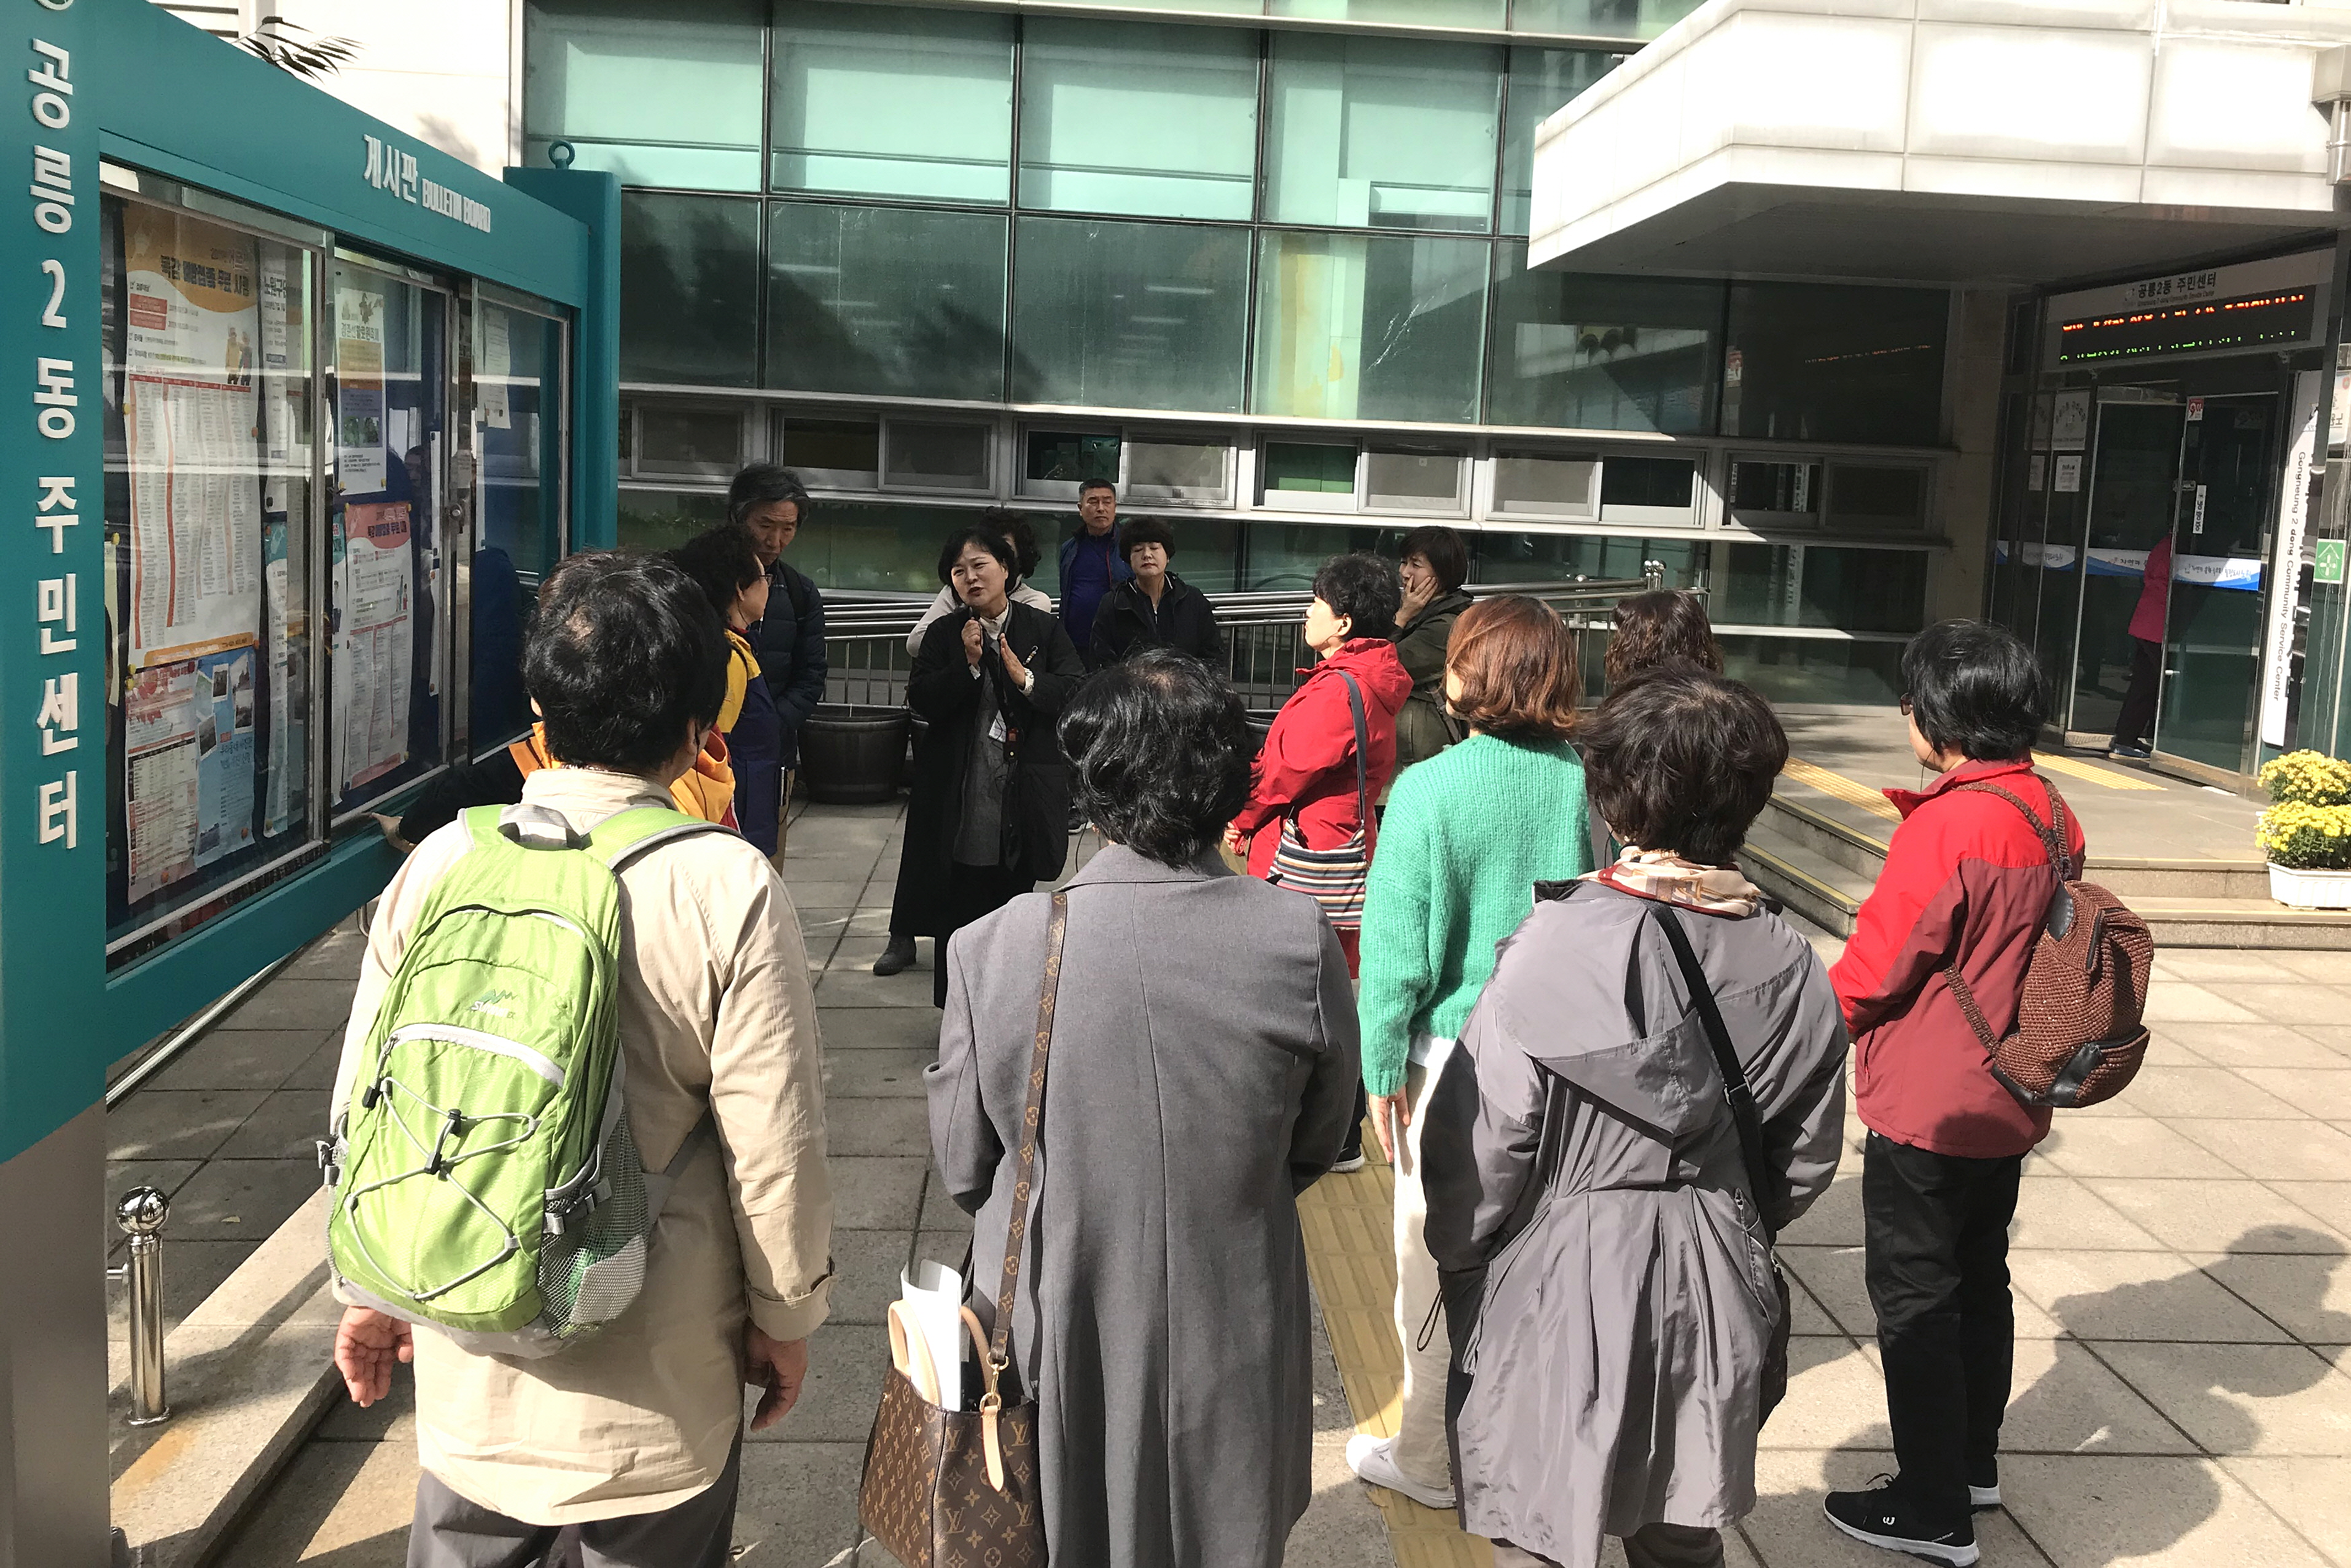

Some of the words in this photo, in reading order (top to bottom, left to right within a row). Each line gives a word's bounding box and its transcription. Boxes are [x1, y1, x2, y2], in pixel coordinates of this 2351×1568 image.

[363, 134, 418, 204] 게시판
[422, 178, 462, 222] BULLETIN
[463, 196, 491, 233] BOARD
[2138, 279, 2172, 298] 공릉2동
[2177, 272, 2216, 292] 주민센터
[2291, 451, 2306, 513] Gongneung
[2283, 529, 2296, 559] dong
[2279, 561, 2294, 619] Community
[36, 477, 78, 849] 주민센터
[2276, 622, 2288, 661] Service
[2273, 666, 2283, 701] Center
